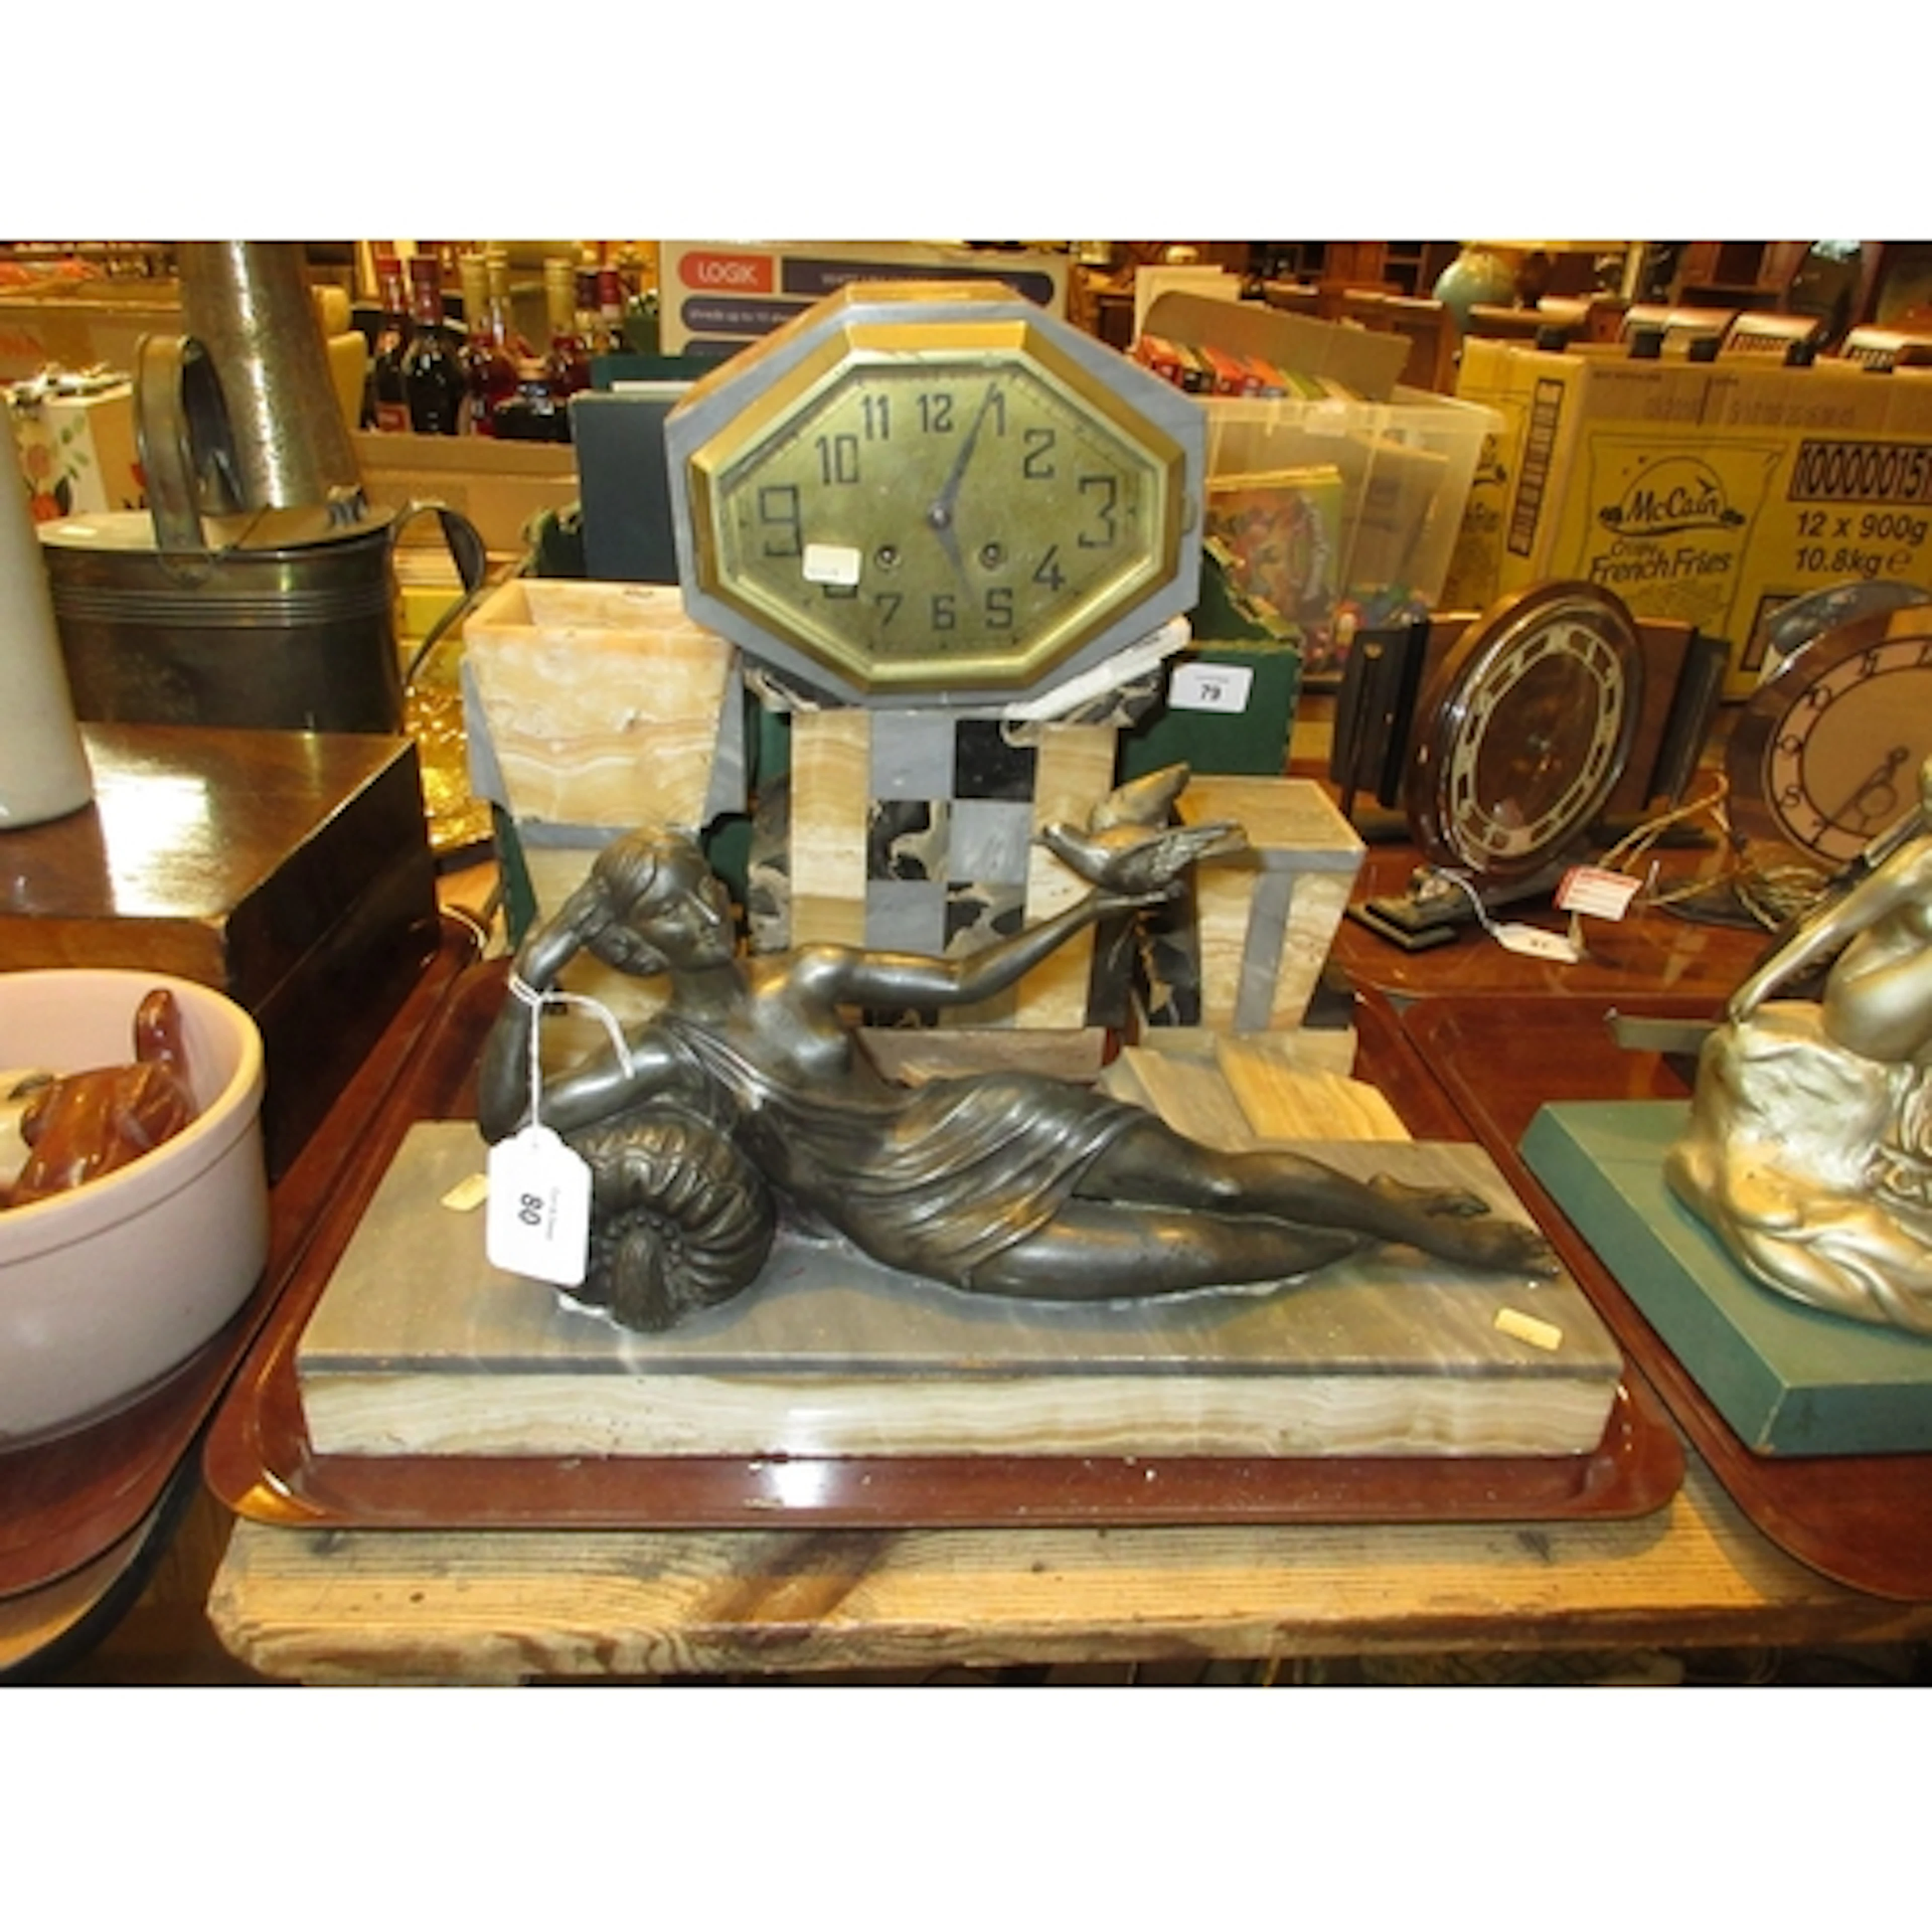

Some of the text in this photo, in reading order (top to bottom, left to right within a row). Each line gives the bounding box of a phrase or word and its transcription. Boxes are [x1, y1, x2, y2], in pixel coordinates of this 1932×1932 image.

[697, 261, 758, 286] LOGIK
[862, 395, 889, 441] 11
[917, 393, 953, 434] 12
[816, 435, 859, 486] 10
[1023, 429, 1056, 479] 2
[759, 484, 803, 557] 9
[1079, 475, 1117, 548] 3
[1627, 480, 1721, 523] McCain
[1797, 511, 1930, 546] 12 x 900g
[1034, 545, 1067, 592] 4
[1588, 549, 1670, 586] French
[1673, 546, 1731, 578] Fries
[874, 593, 904, 628] 7
[931, 595, 955, 631] 6
[986, 588, 1013, 630] 5
[518, 1192, 543, 1226] 80
